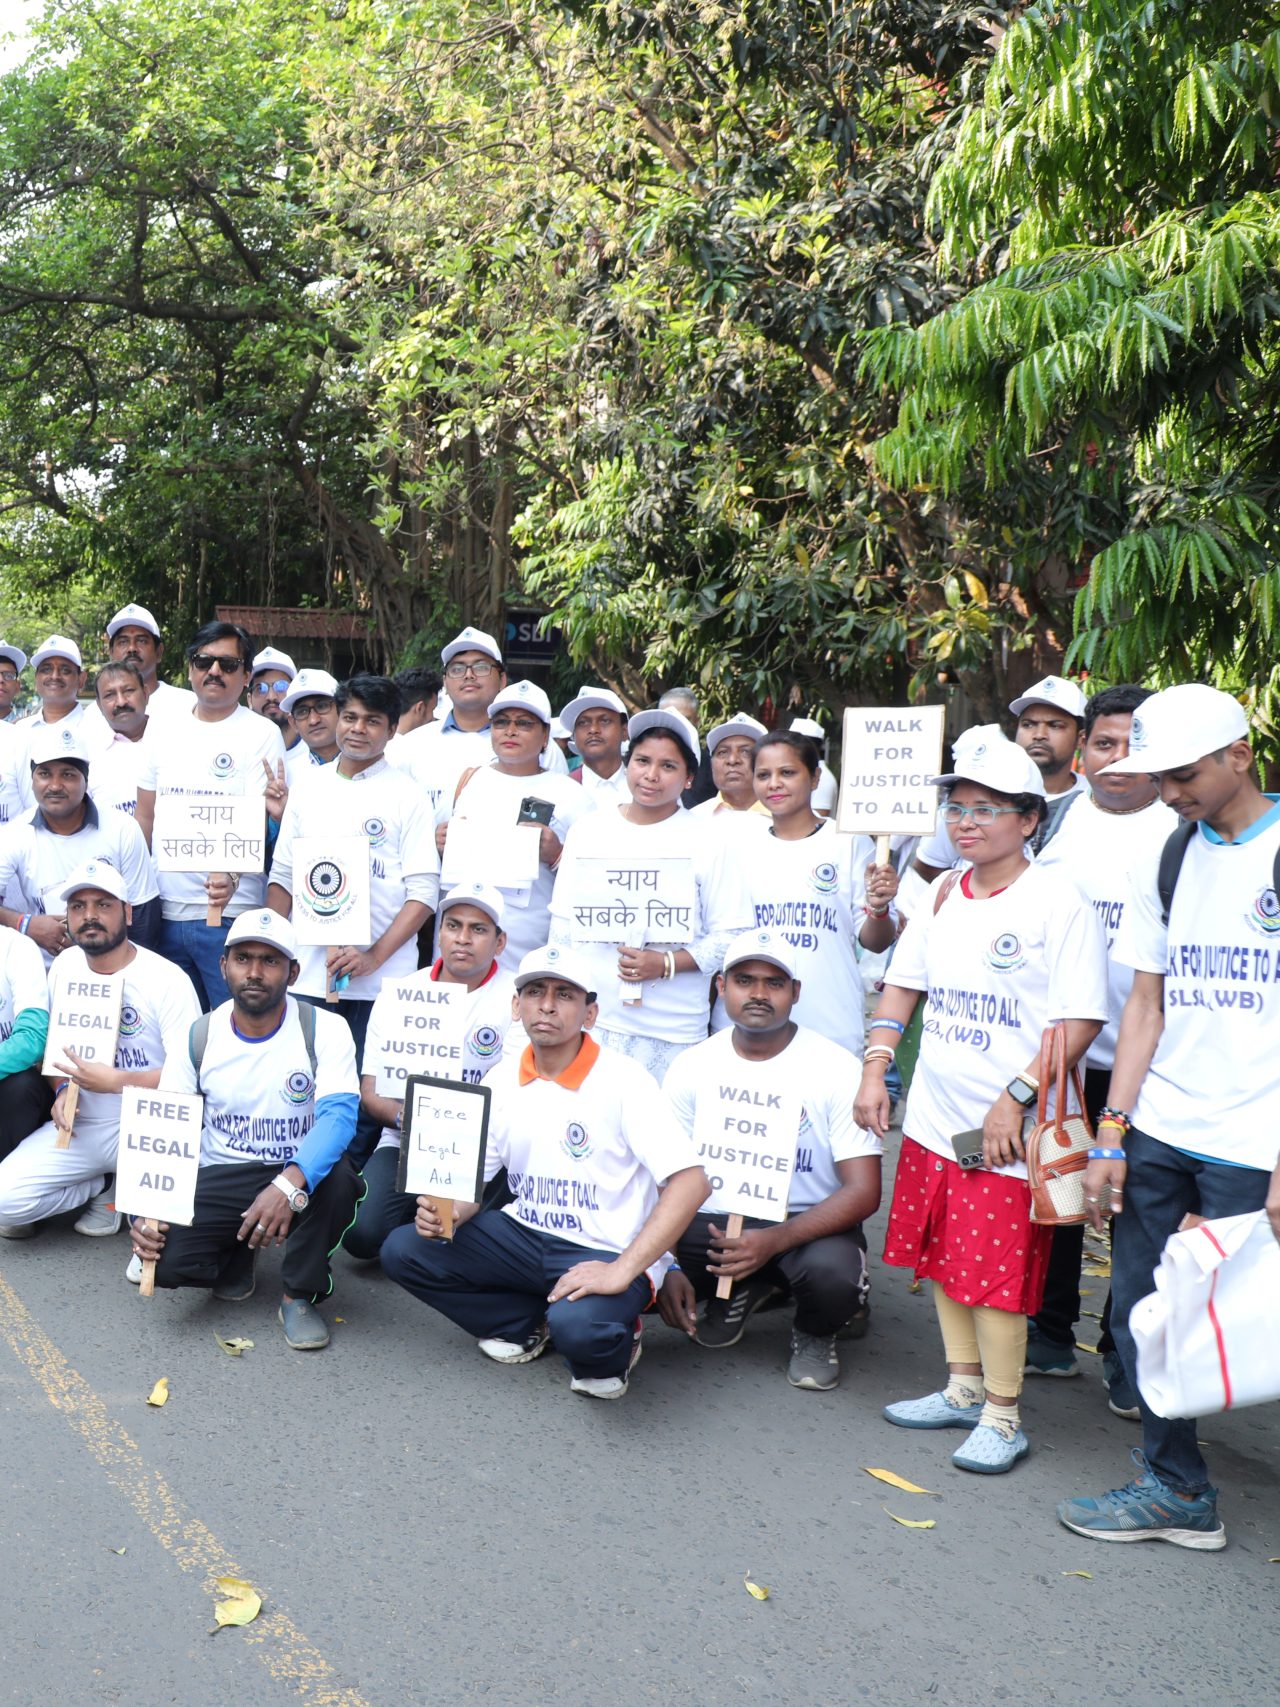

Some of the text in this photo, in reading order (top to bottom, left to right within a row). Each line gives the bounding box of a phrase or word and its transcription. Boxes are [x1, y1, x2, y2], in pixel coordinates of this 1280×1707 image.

[865, 719, 922, 733] WALK
[874, 747, 913, 760] FOR
[850, 774, 935, 787] JUSTICE
[189, 806, 235, 825] न्याय
[852, 801, 929, 814] TO ALL
[161, 832, 262, 862] सबके लिए
[606, 870, 660, 891] न्याय
[573, 898, 692, 931] सबके लिए
[810, 903, 822, 928] TO
[1204, 945, 1249, 981] JUTICE
[1253, 948, 1269, 983] TO
[67, 982, 111, 998] FREE
[397, 988, 450, 1005] WALK
[981, 994, 997, 1024] TO
[999, 997, 1021, 1028] ALL
[58, 1013, 113, 1030] LEGAL
[404, 1015, 441, 1030] FOR
[132, 1047, 149, 1068] ALL
[381, 1040, 460, 1059] JUSTICE
[384, 1066, 408, 1080] TO
[719, 1085, 782, 1109] WALK
[136, 1099, 190, 1122] FREE
[417, 1096, 467, 1121] Free
[252, 1117, 286, 1142] JUSTICE
[288, 1116, 300, 1140] TO
[724, 1117, 768, 1137] FOR
[127, 1133, 195, 1160] LEGAL
[697, 1143, 789, 1172] JUSTICE
[795, 1148, 813, 1173] ALL
[139, 1172, 175, 1192] AID
[429, 1168, 452, 1185] Aid
[536, 1176, 568, 1207] JUSTICE
[737, 1182, 778, 1202] ALL
